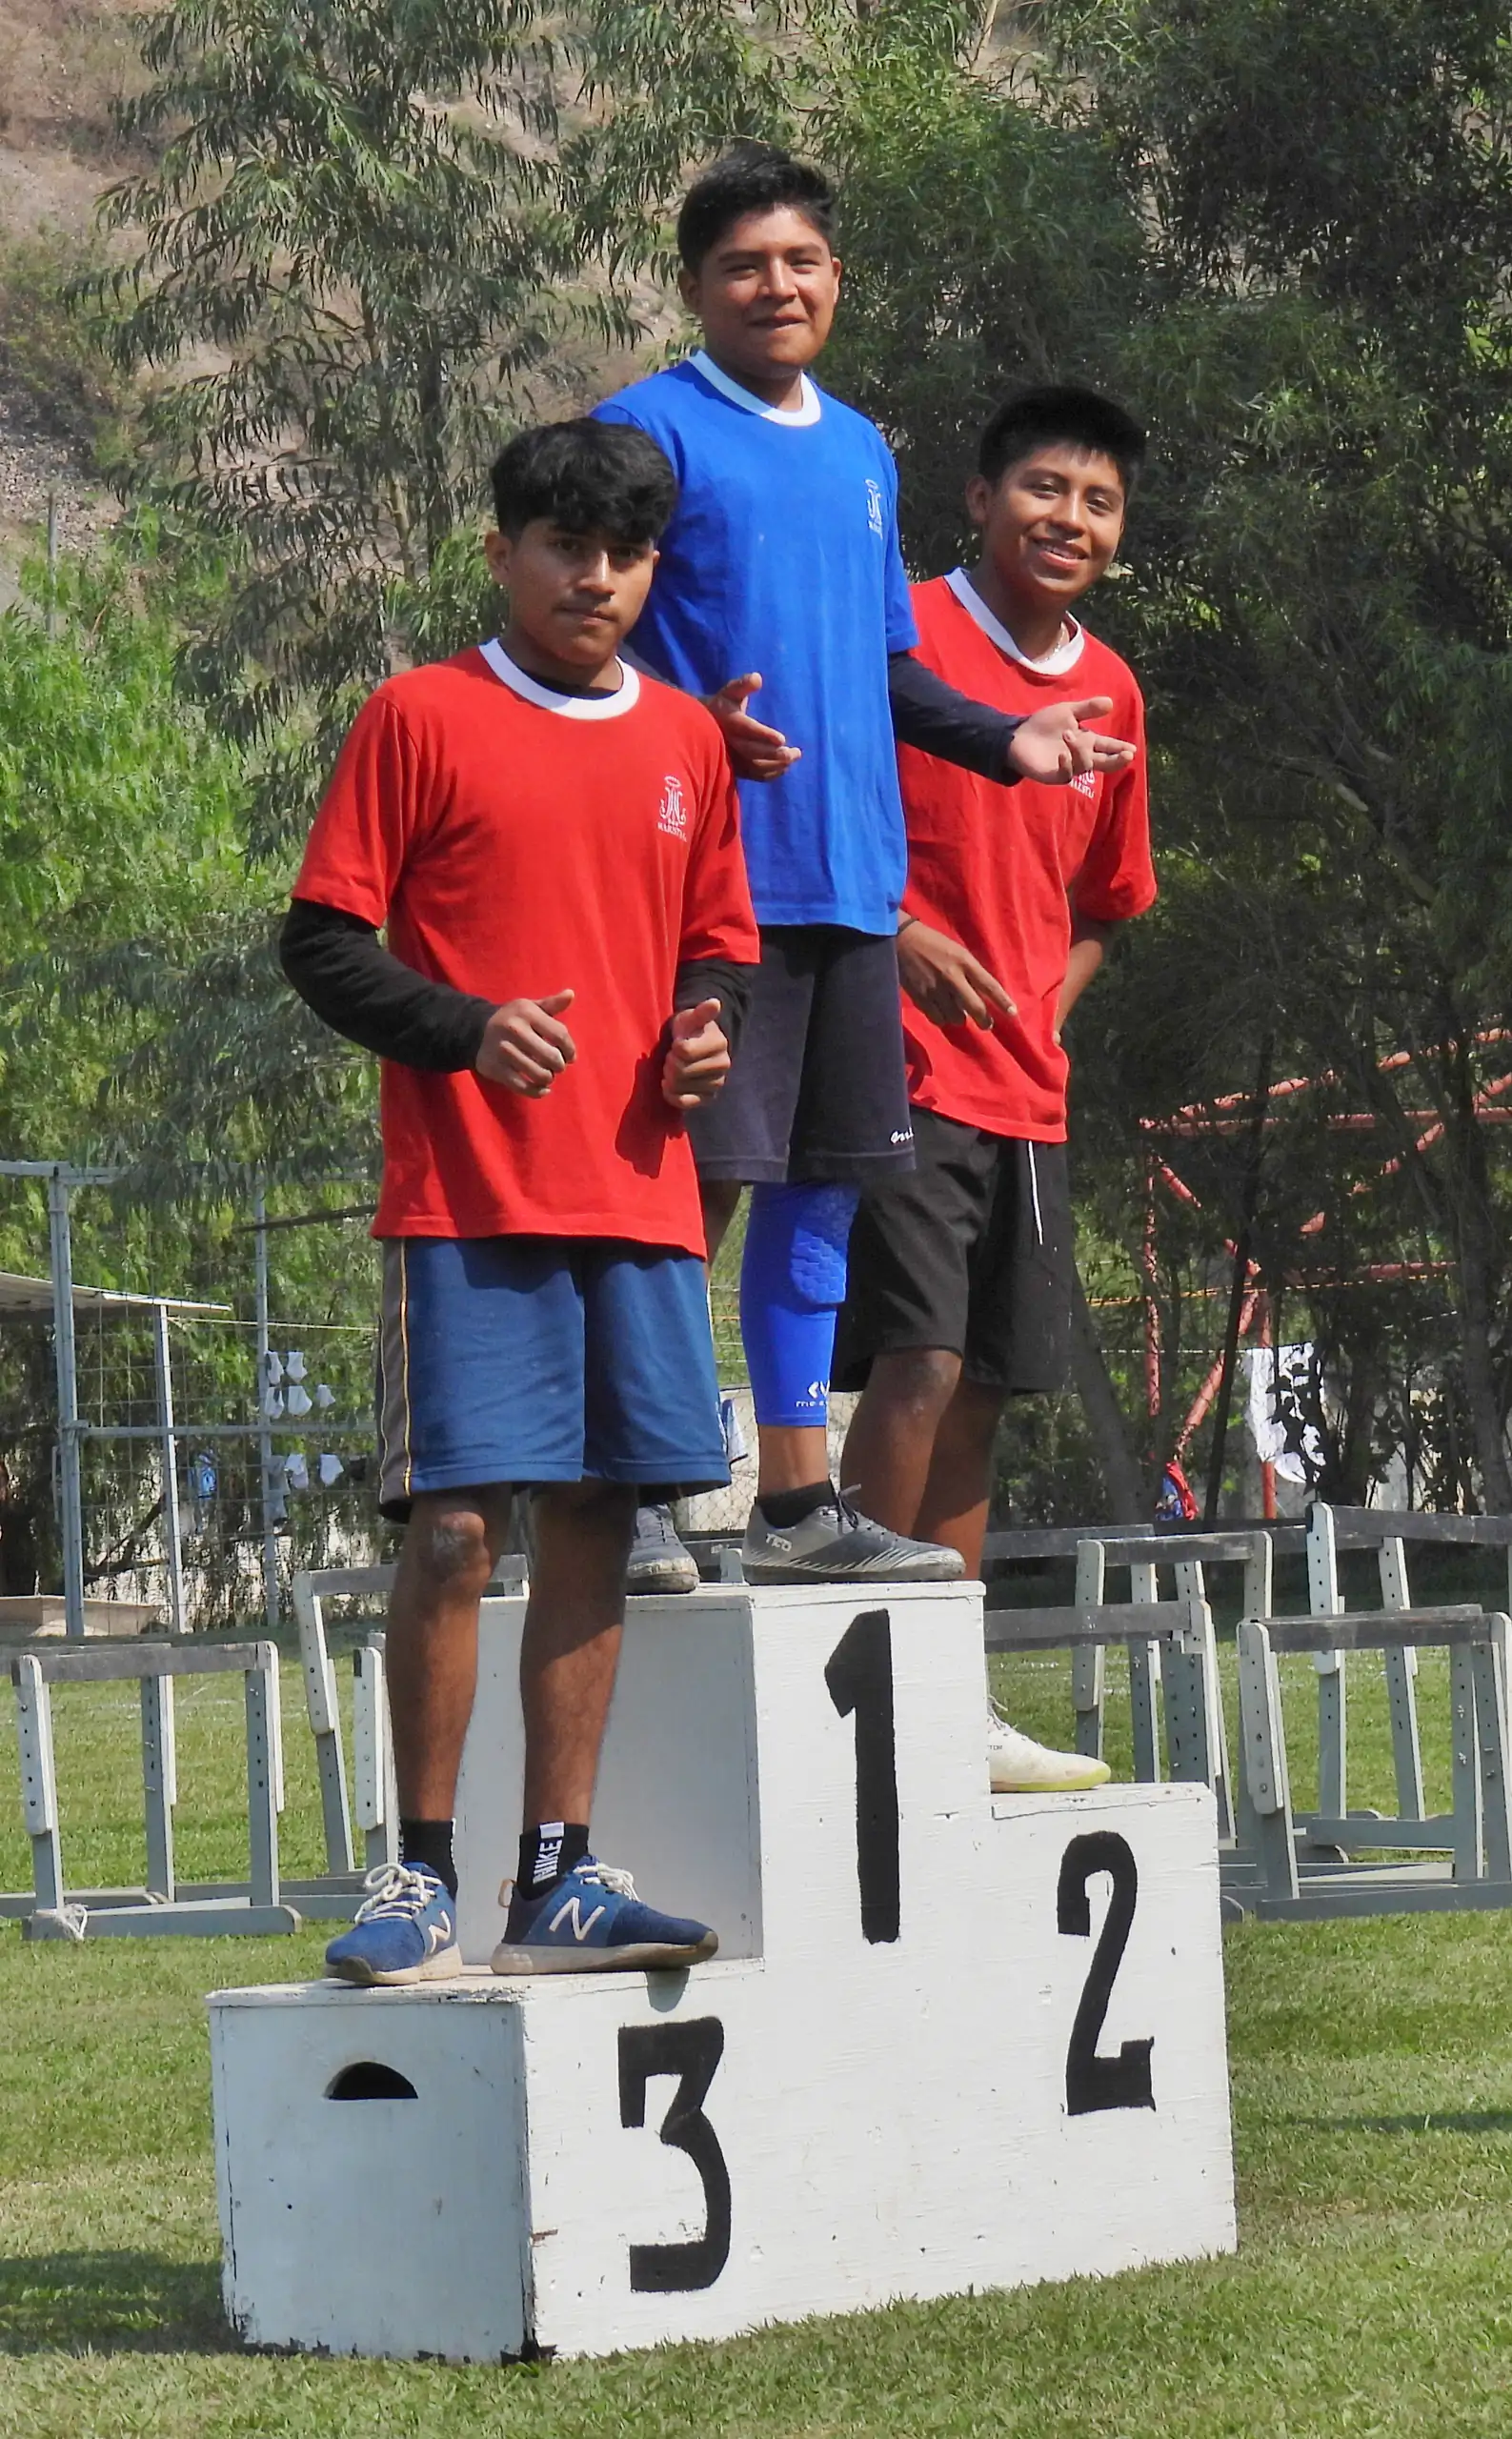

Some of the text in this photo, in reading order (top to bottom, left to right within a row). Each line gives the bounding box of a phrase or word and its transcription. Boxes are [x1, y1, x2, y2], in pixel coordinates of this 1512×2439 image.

[533, 1839, 563, 1885] NIKE
[825, 1609, 900, 1945] 1
[1057, 1831, 1156, 2116] 2
[618, 2017, 731, 2292] 3
